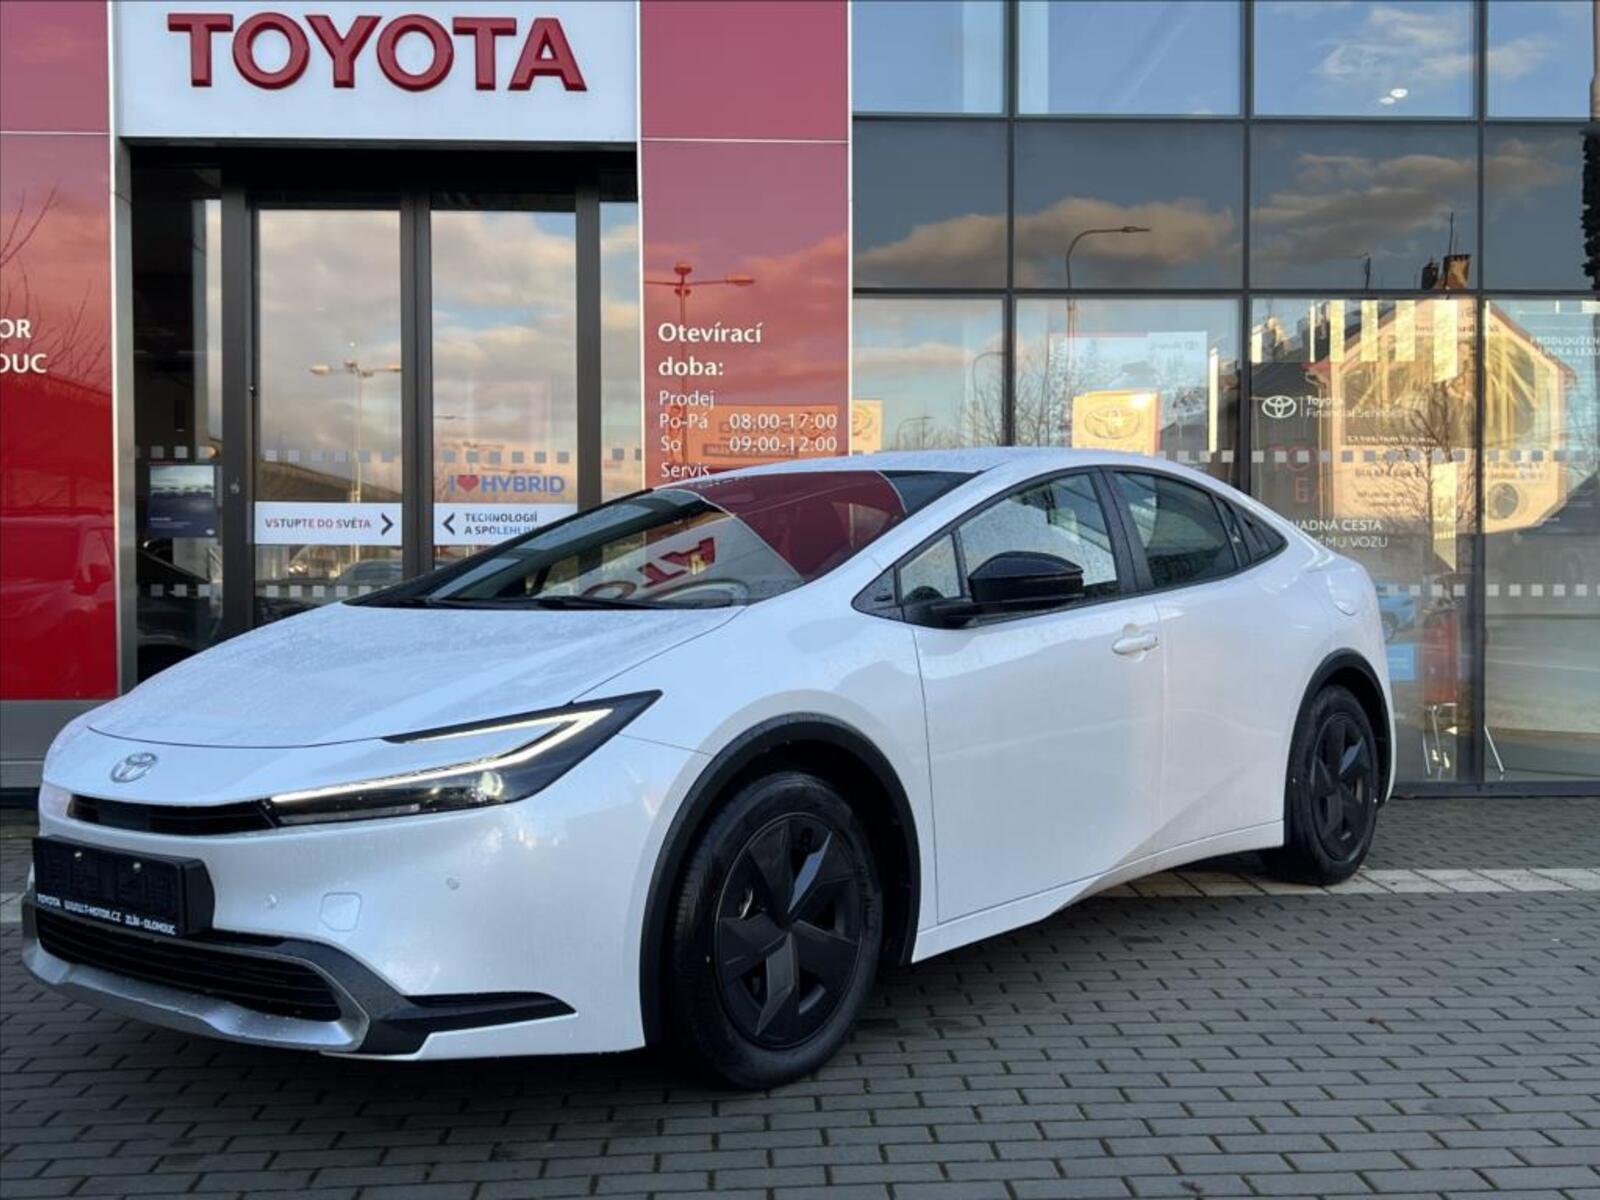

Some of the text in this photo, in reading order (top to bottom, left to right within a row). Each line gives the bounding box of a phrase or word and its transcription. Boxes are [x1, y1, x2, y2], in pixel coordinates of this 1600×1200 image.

[167, 12, 588, 92] TOYOTA
[657, 322, 764, 343] Otevírací
[657, 356, 724, 376] doba:
[659, 390, 715, 408] Prodej
[1306, 395, 1344, 408] Toyo
[659, 412, 838, 429] Po-Pá 08:00-17:00
[660, 436, 838, 452] So 09:00-12:00
[660, 461, 711, 479] Servis
[447, 475, 565, 493] I HYBRID
[264, 516, 373, 529] VSTUPTE DO SVĚTA
[464, 526, 473, 535] A
[1341, 519, 1382, 532] CESTA
[1350, 535, 1388, 549] VOZU
